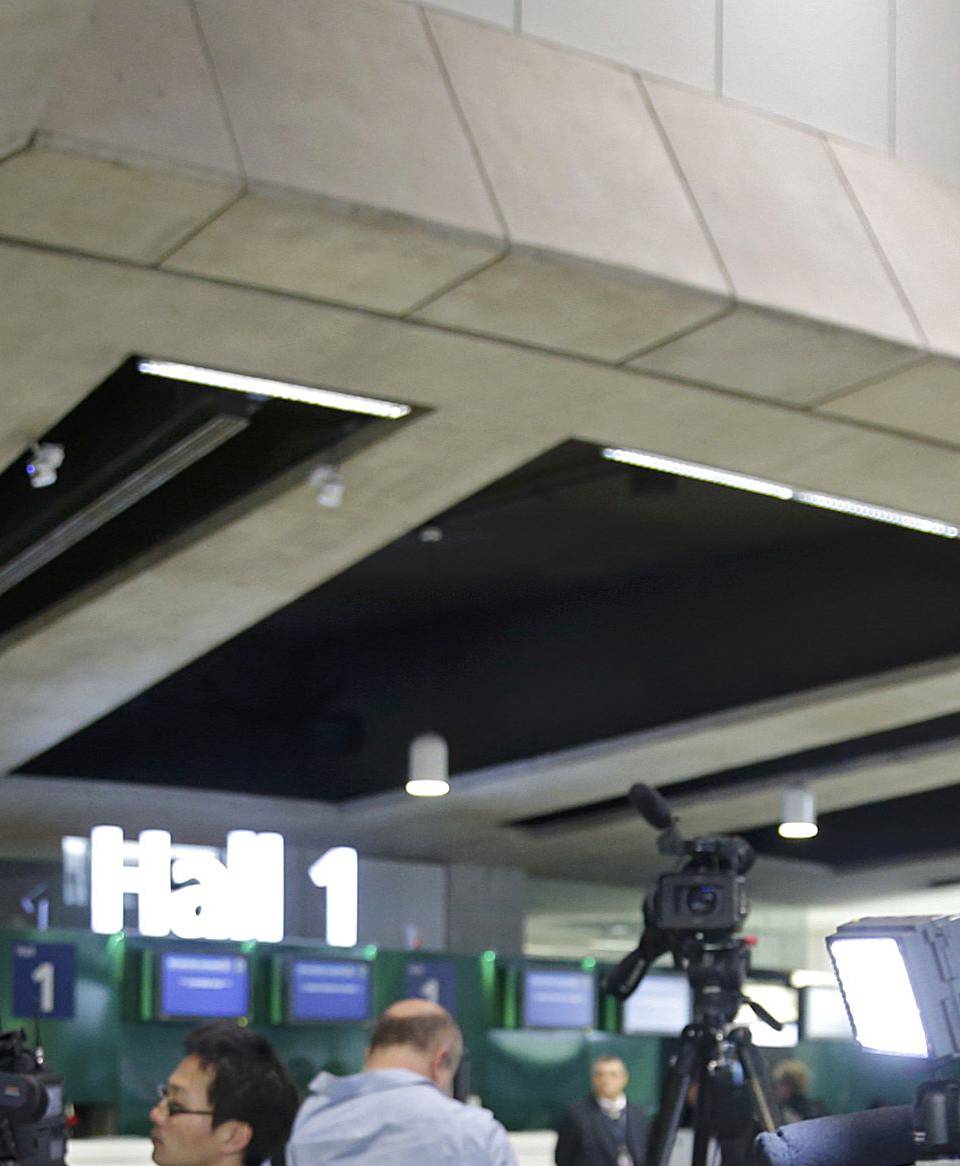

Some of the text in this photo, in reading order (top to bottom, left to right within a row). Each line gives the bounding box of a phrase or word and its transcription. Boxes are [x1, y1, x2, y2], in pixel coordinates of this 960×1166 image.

[90, 825, 358, 947] Hall 1
[31, 961, 56, 1013] 1
